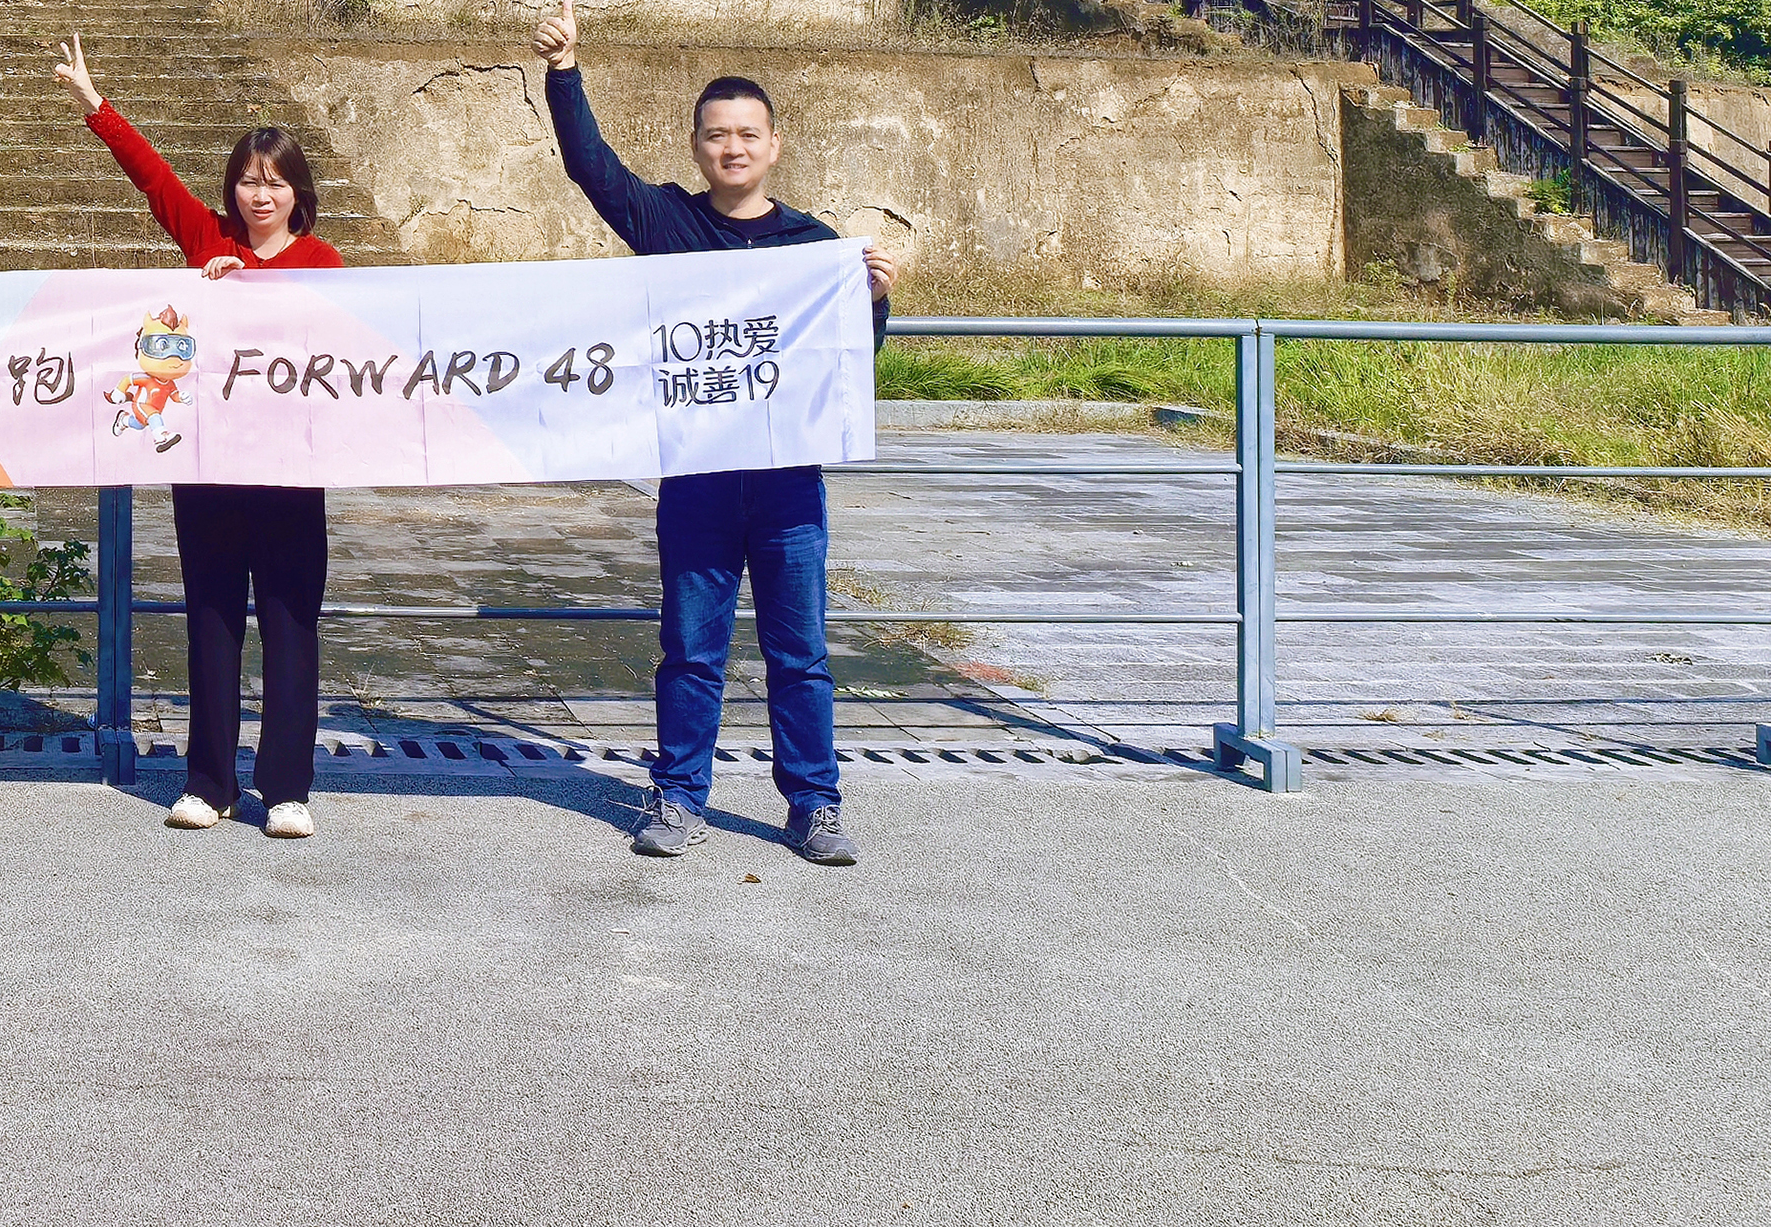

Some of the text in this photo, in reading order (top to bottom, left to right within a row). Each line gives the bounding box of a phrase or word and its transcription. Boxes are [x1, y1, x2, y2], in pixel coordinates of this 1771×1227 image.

[653, 315, 780, 363] 10热爱
[222, 348, 521, 400] FORWARD
[543, 342, 615, 396] 48
[657, 360, 780, 408] 诚善19
